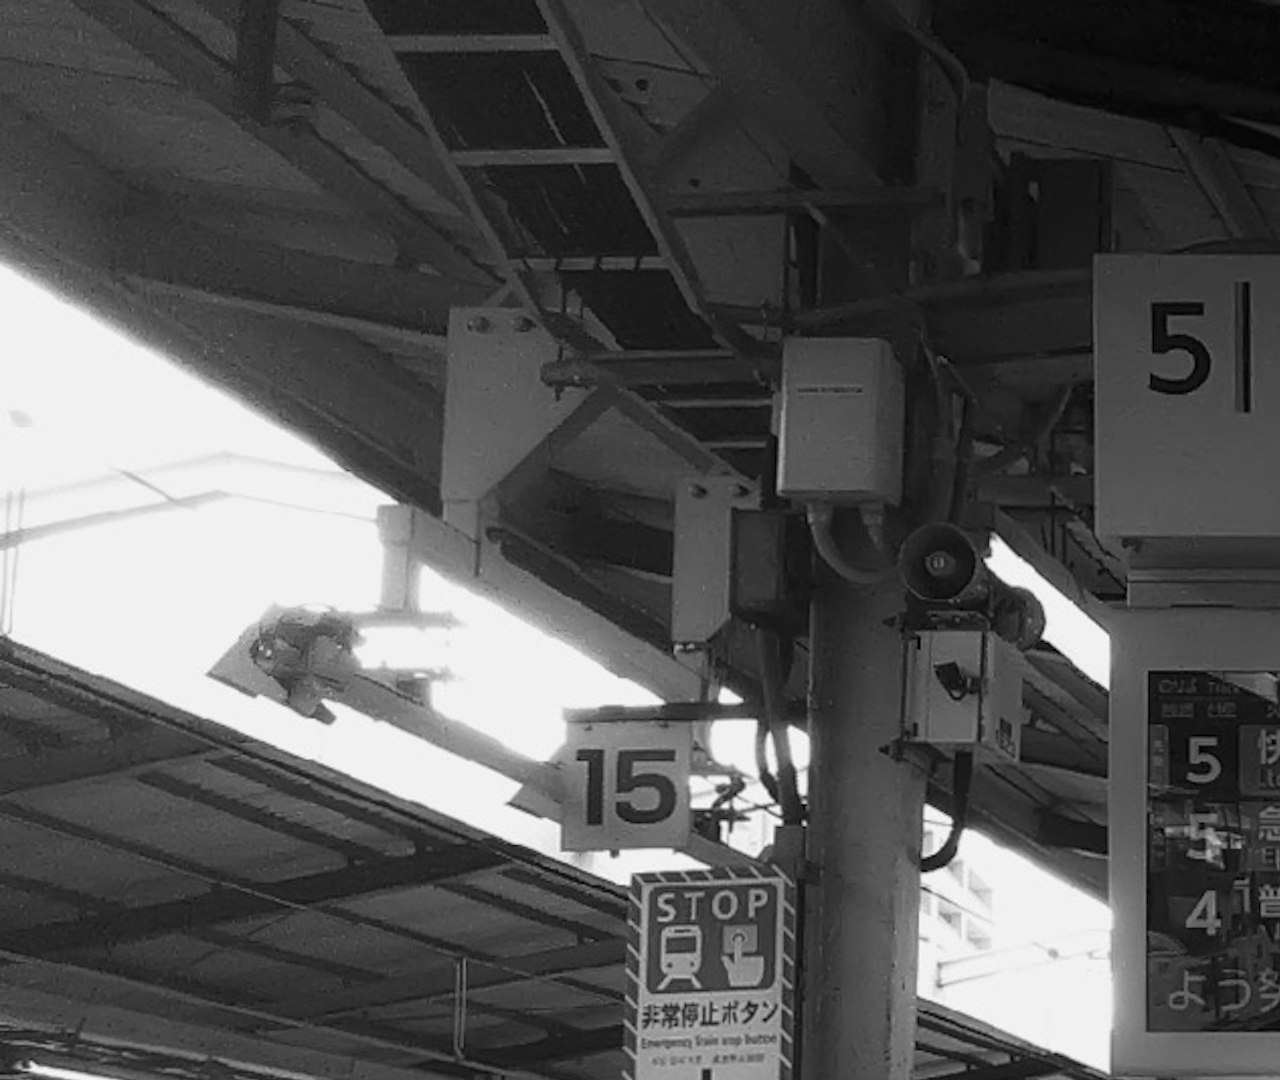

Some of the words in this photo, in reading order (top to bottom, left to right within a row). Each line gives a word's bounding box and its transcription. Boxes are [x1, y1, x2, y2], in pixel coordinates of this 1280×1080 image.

[1149, 302, 1211, 394] 5
[1186, 736, 1223, 784] 5
[577, 748, 678, 827] 15
[656, 888, 770, 925] STOP
[1185, 889, 1223, 937] 4
[641, 1000, 780, 1031] 非常停止ボタン
